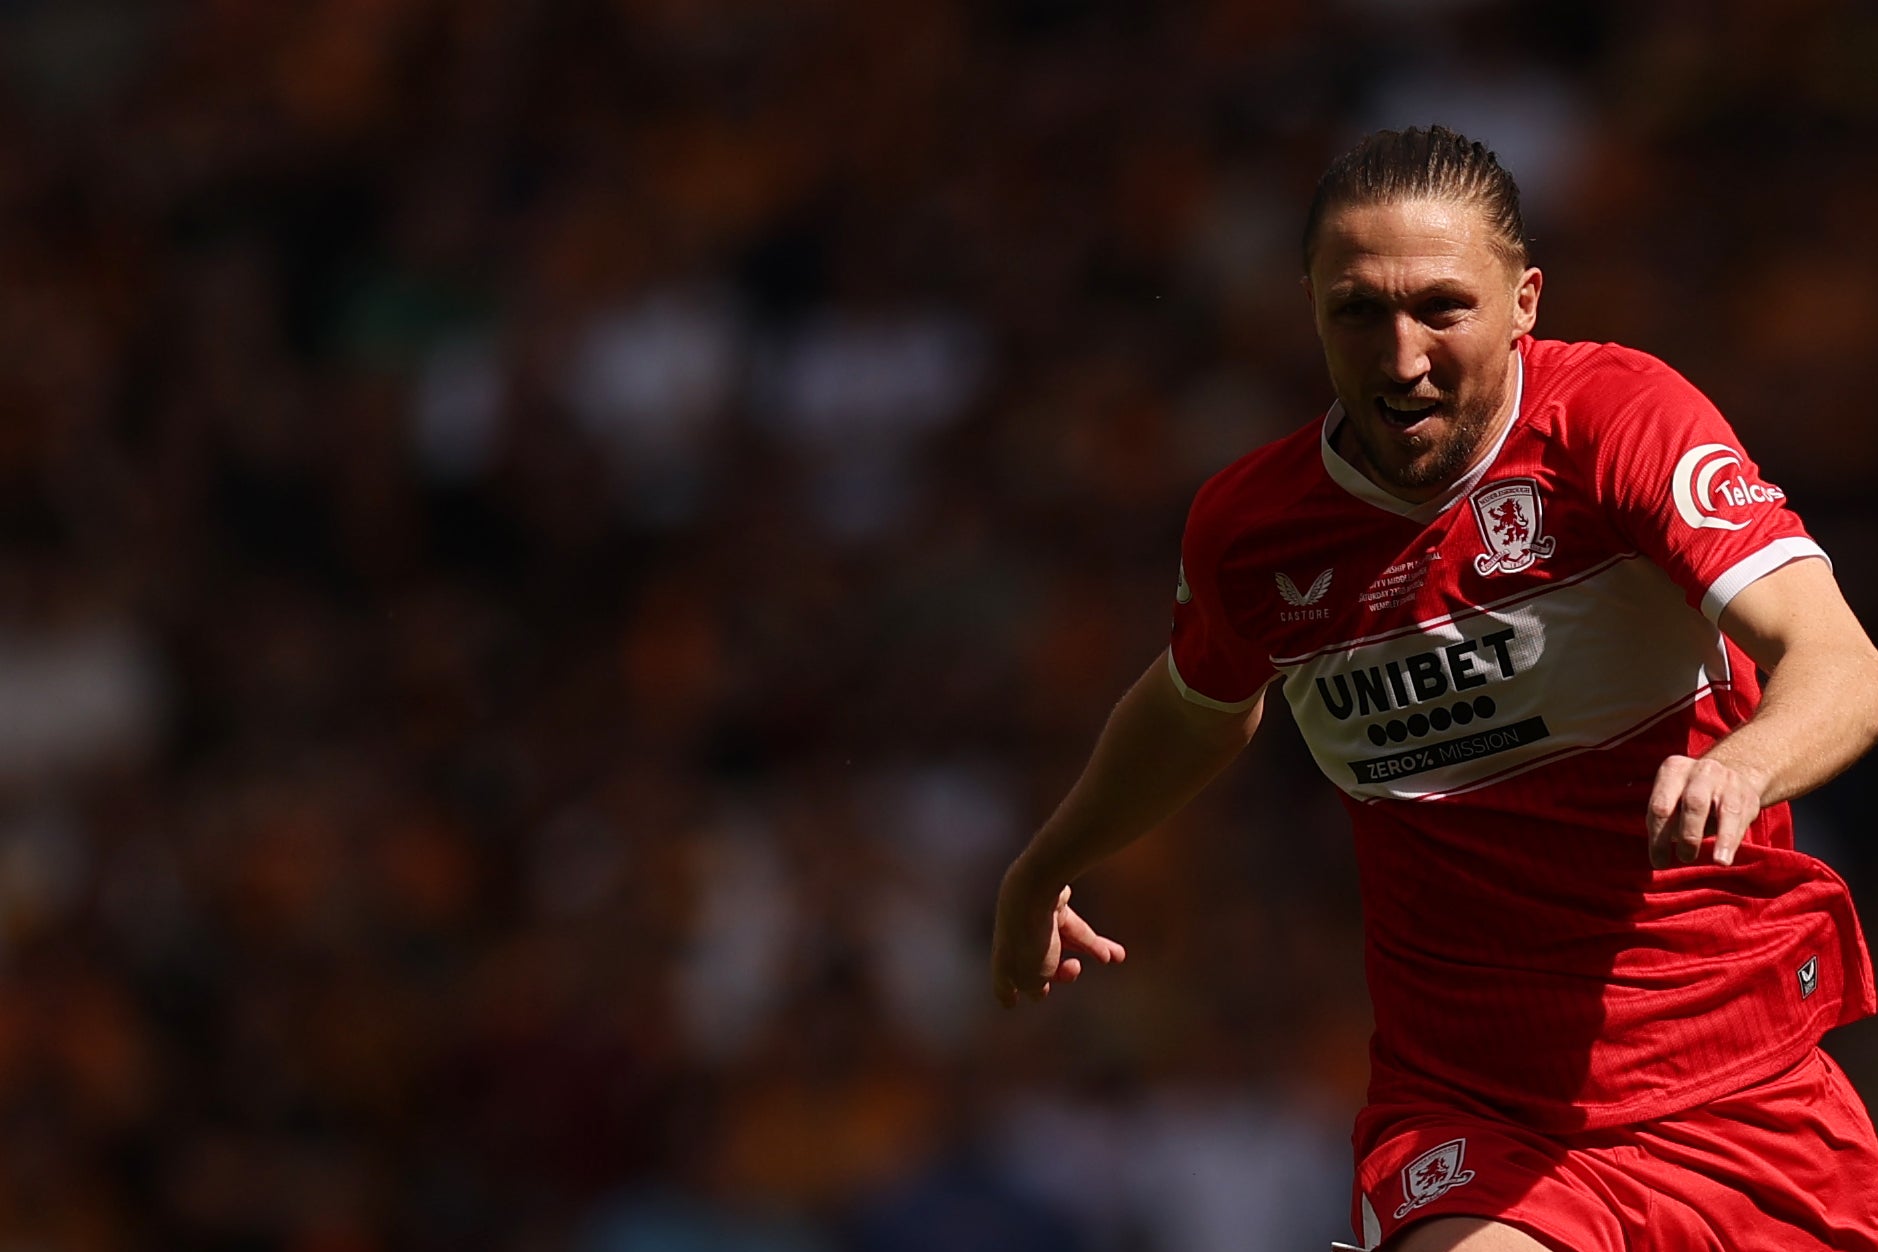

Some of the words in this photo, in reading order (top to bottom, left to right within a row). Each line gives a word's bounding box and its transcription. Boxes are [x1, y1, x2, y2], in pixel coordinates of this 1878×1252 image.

[1280, 608, 1330, 622] CASTORE
[1316, 628, 1515, 720] UNIBET
[1366, 750, 1434, 780] ZERO%
[1438, 728, 1520, 761] MISSION
